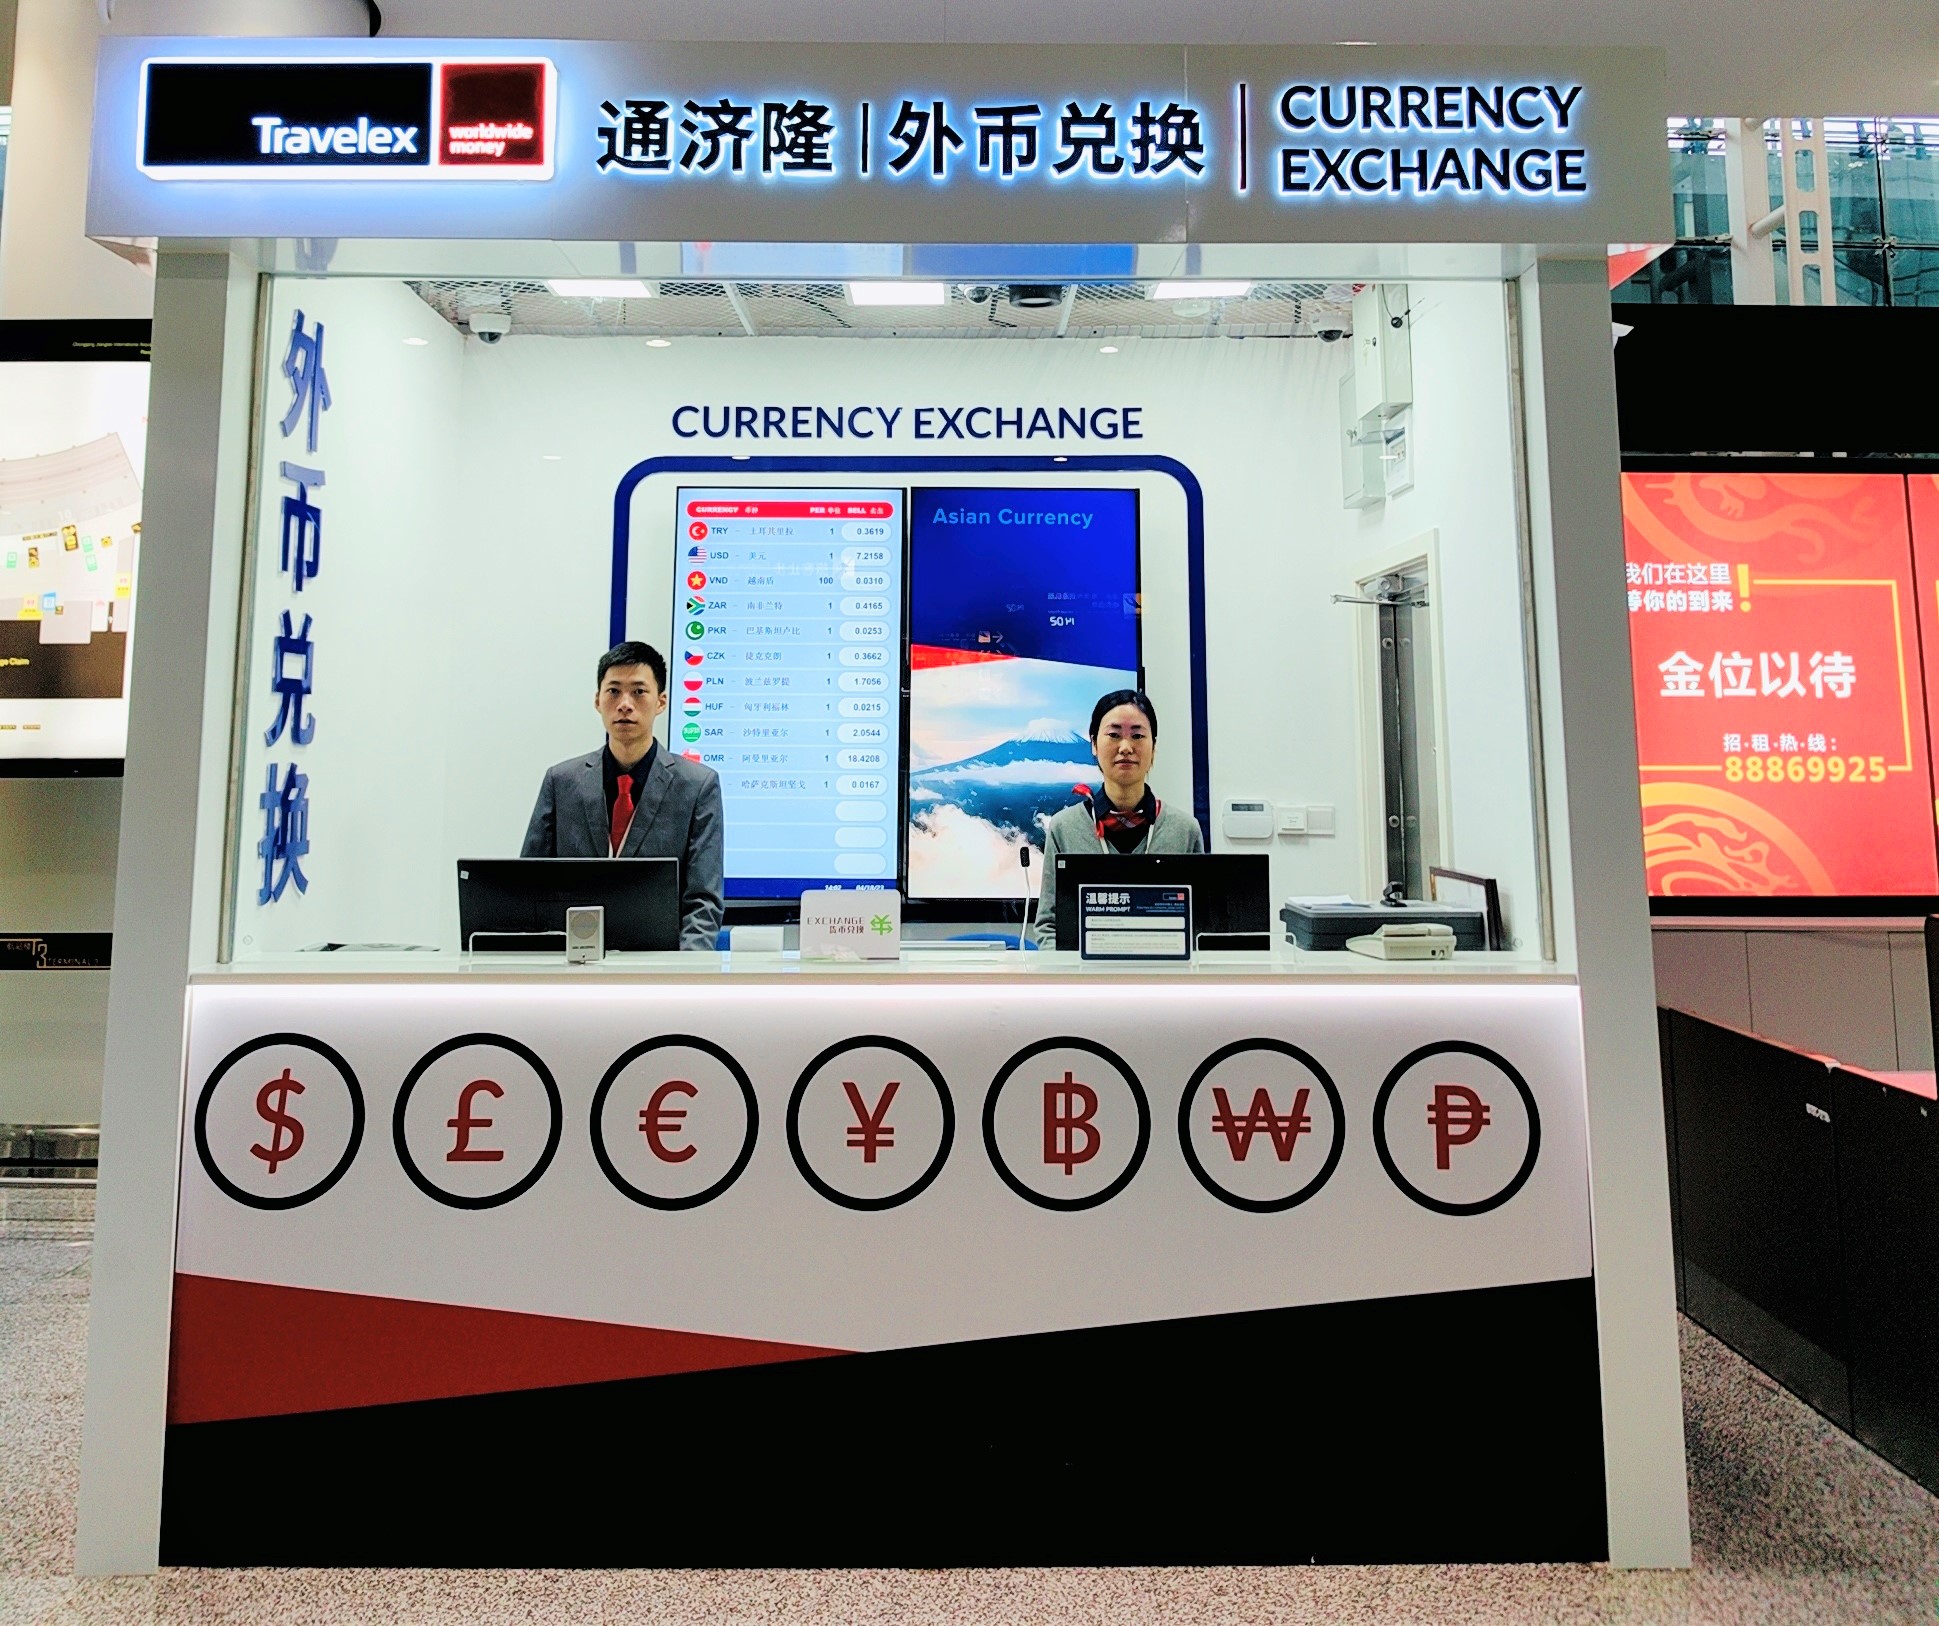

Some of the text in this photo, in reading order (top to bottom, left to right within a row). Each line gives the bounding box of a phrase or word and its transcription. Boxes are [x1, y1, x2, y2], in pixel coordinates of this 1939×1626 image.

[1281, 84, 1583, 130] CURRENCY
[448, 122, 534, 140] worldwide
[252, 117, 418, 156] Travelex
[597, 99, 1206, 176] 通济隆 外币兑换
[449, 141, 506, 157] money
[1282, 147, 1587, 193] EXCHANGE
[671, 405, 1144, 440] CURRENCY EXCHANGE
[695, 506, 739, 514] CURRENCY
[809, 506, 826, 514] PER
[932, 508, 1093, 529] Asian Currency
[711, 527, 729, 535] TRY
[856, 527, 885, 536] 0.3619
[710, 551, 729, 559] USD
[829, 552, 833, 560] 1
[856, 552, 884, 560] 7.2158
[709, 576, 728, 585] VND
[818, 577, 834, 585] 100
[855, 577, 884, 585] 0.0310
[256, 308, 332, 906] 外币兑换
[708, 601, 727, 609] ZAR
[828, 602, 832, 610] 1
[855, 602, 883, 610] 0.4165
[707, 626, 727, 635] PKR
[828, 627, 832, 635] 1
[854, 627, 883, 635] 0.0253
[706, 652, 725, 660] CZK
[827, 652, 831, 660] 1
[854, 652, 882, 660] 0.3662
[1658, 650, 1856, 700] 金位以待
[705, 677, 724, 685] PLN
[854, 677, 882, 686] 1.7056
[704, 702, 724, 711] HUF
[826, 703, 830, 711] 1
[853, 703, 881, 711] 0.0215
[704, 728, 724, 737] SAR
[852, 728, 881, 737] 2.0544
[703, 753, 725, 762] OMR
[825, 754, 829, 762] 1
[847, 754, 880, 763] 18.4208
[1725, 756, 1886, 783] 88869925
[851, 780, 880, 789] 0.0167
[806, 917, 865, 925] EXCHANGE
